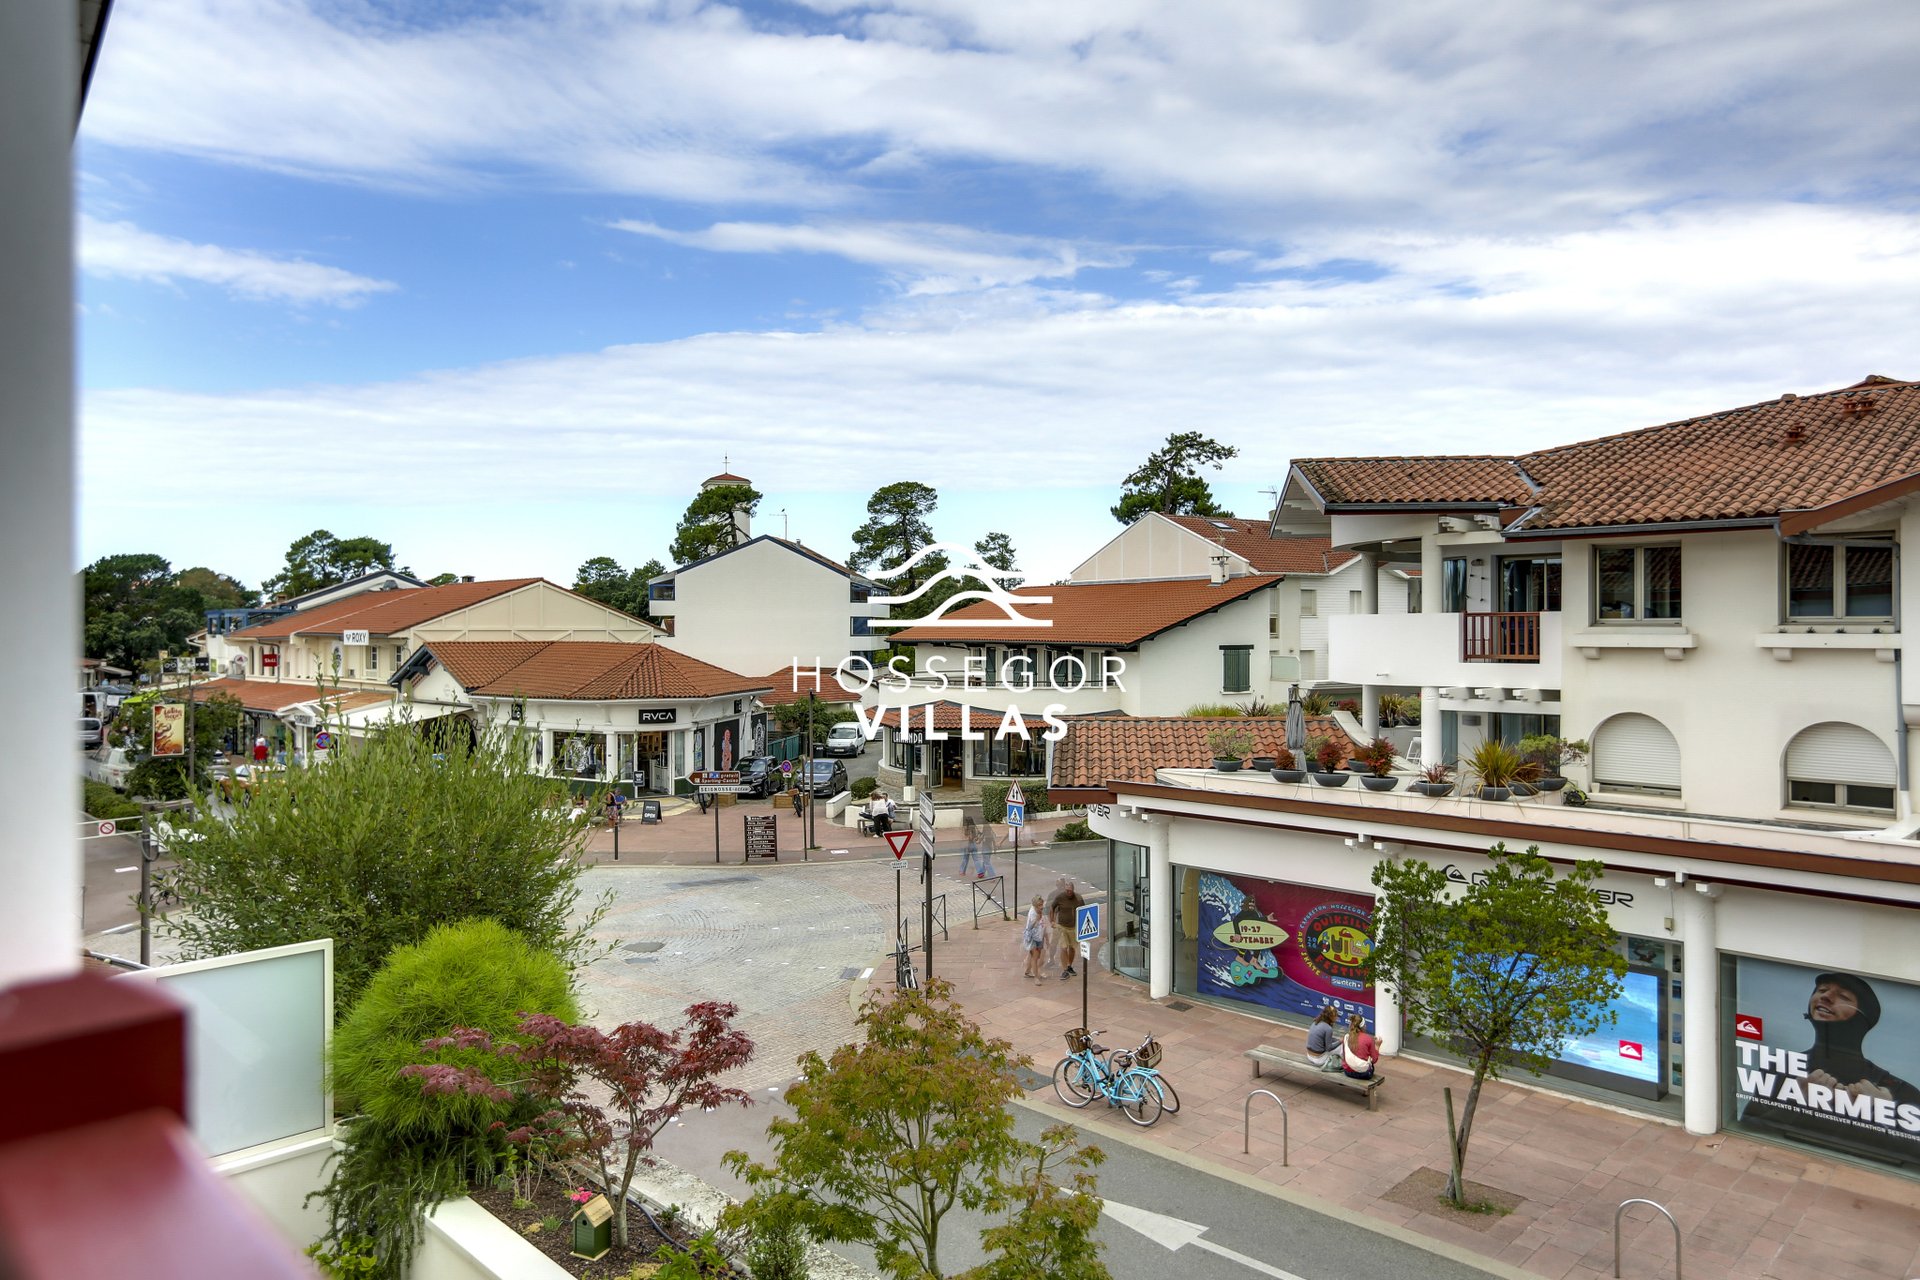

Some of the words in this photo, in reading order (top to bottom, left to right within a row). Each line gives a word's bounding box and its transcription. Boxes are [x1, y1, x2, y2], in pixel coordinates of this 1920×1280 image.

[351, 632, 367, 643] ROXY
[642, 712, 674, 720] RVCA
[1240, 925, 1261, 933] 19-27
[1229, 935, 1274, 944] SPTEMBRE
[1300, 952, 1321, 976] SKATE
[1735, 1039, 1809, 1079] THE
[1735, 1093, 1759, 1102] GRIFFIN
[1760, 1099, 1792, 1111] COLAPINTO
[1802, 1108, 1813, 1116] THE
[1814, 1111, 1851, 1124] QUIKSILVER
[1852, 1120, 1886, 1133] MARATHON
